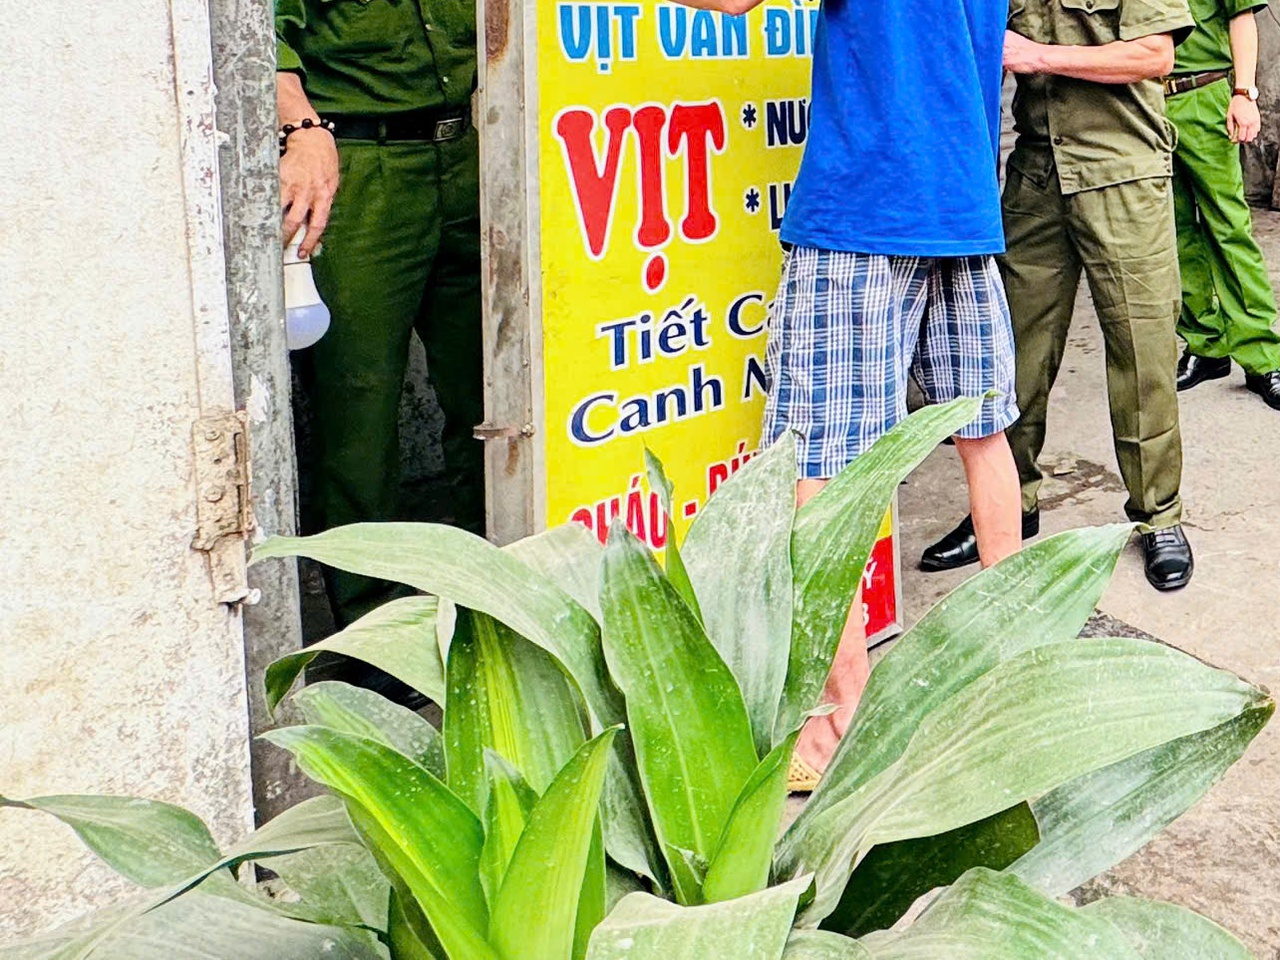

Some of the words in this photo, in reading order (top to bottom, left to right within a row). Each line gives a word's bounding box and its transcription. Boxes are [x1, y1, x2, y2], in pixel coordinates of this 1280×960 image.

[560, 5, 640, 71] VỊT
[557, 101, 726, 290] VỊT
[601, 297, 709, 367] Tiết
[571, 368, 723, 443] Canh
